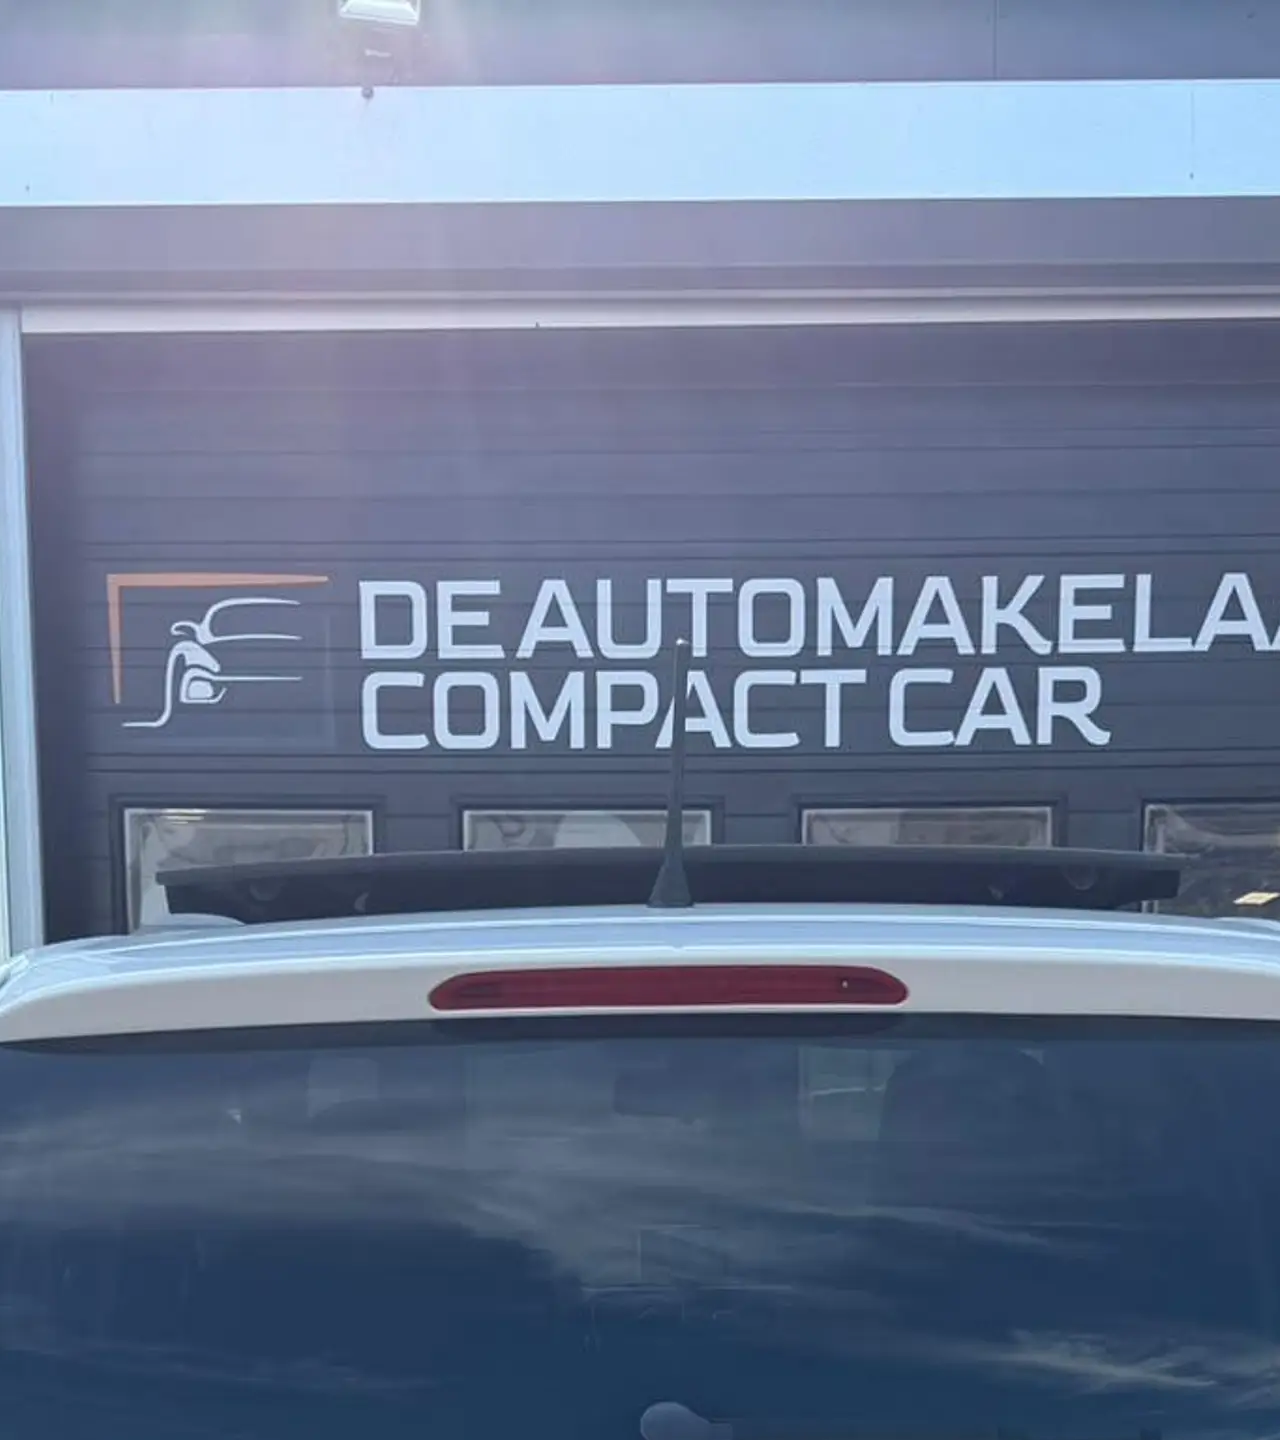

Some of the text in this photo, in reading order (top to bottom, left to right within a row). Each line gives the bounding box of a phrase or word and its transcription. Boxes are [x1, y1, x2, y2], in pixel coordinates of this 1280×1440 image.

[358, 579, 506, 660] DE
[360, 666, 1112, 750] COMPACT CAR
